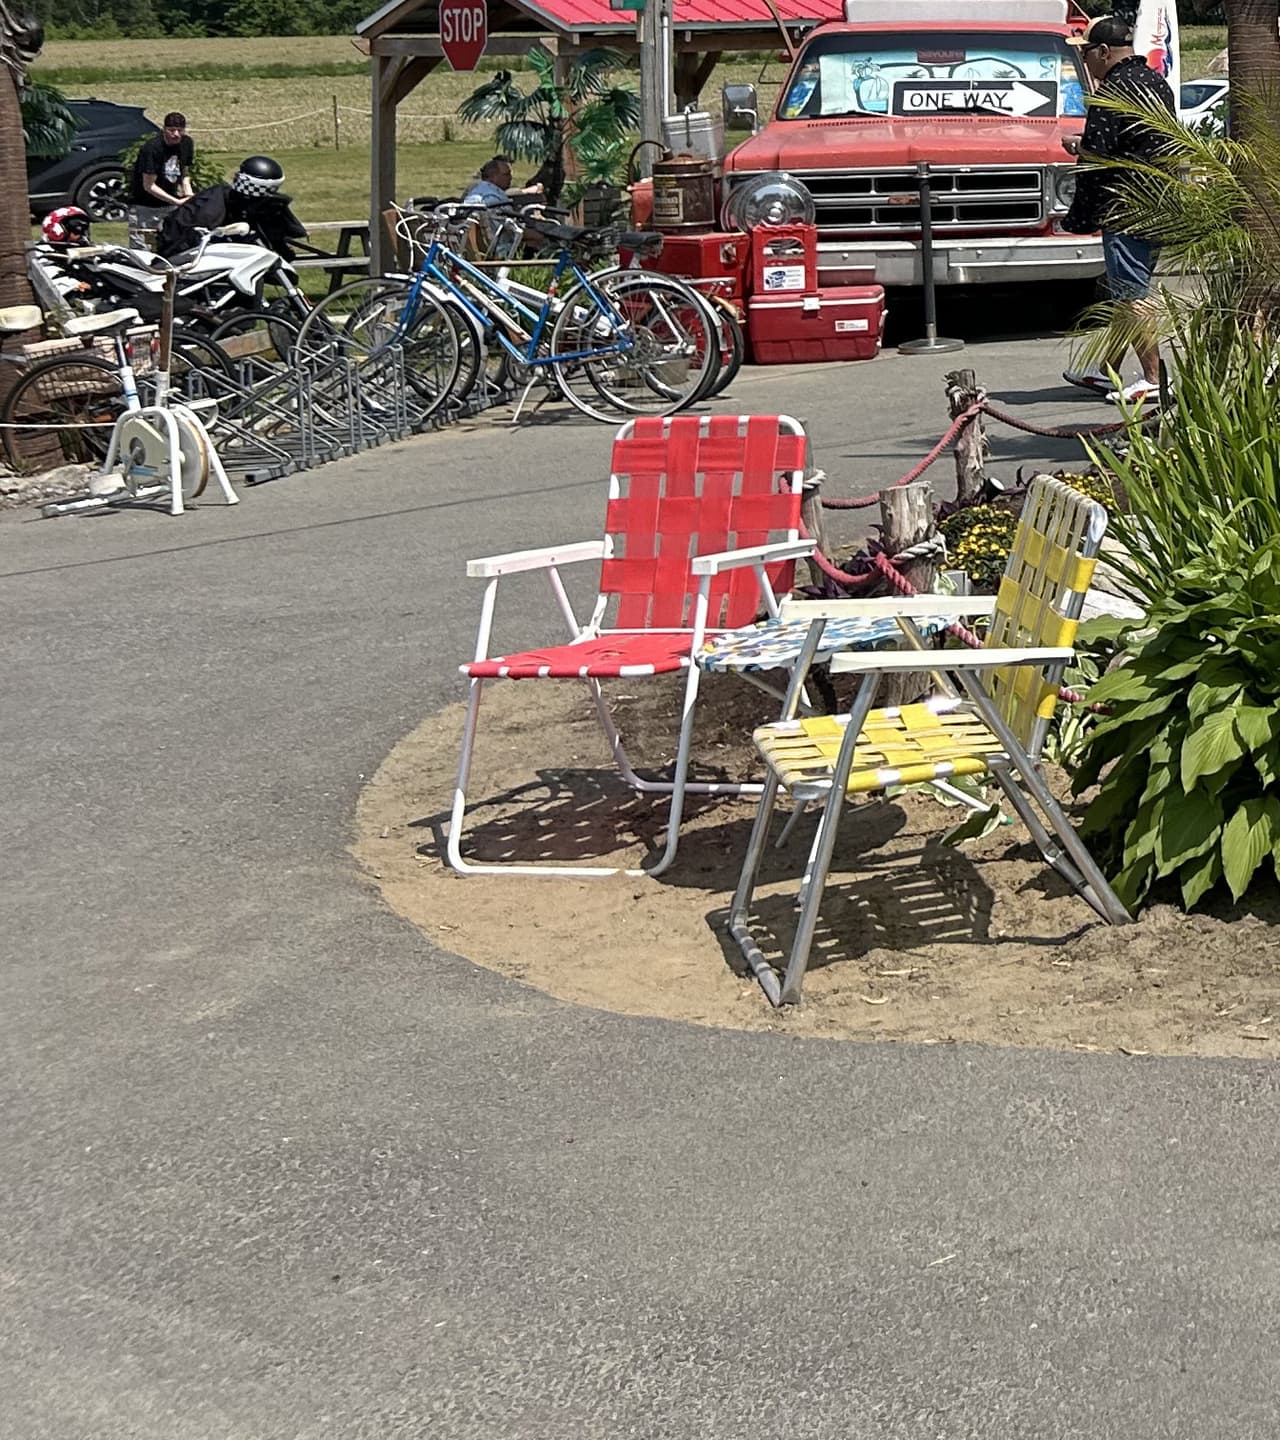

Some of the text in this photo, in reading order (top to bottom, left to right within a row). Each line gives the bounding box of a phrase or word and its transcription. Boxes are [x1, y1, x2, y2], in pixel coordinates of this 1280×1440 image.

[443, 7, 484, 43] STOP
[910, 92, 1008, 108] ONE WAY
